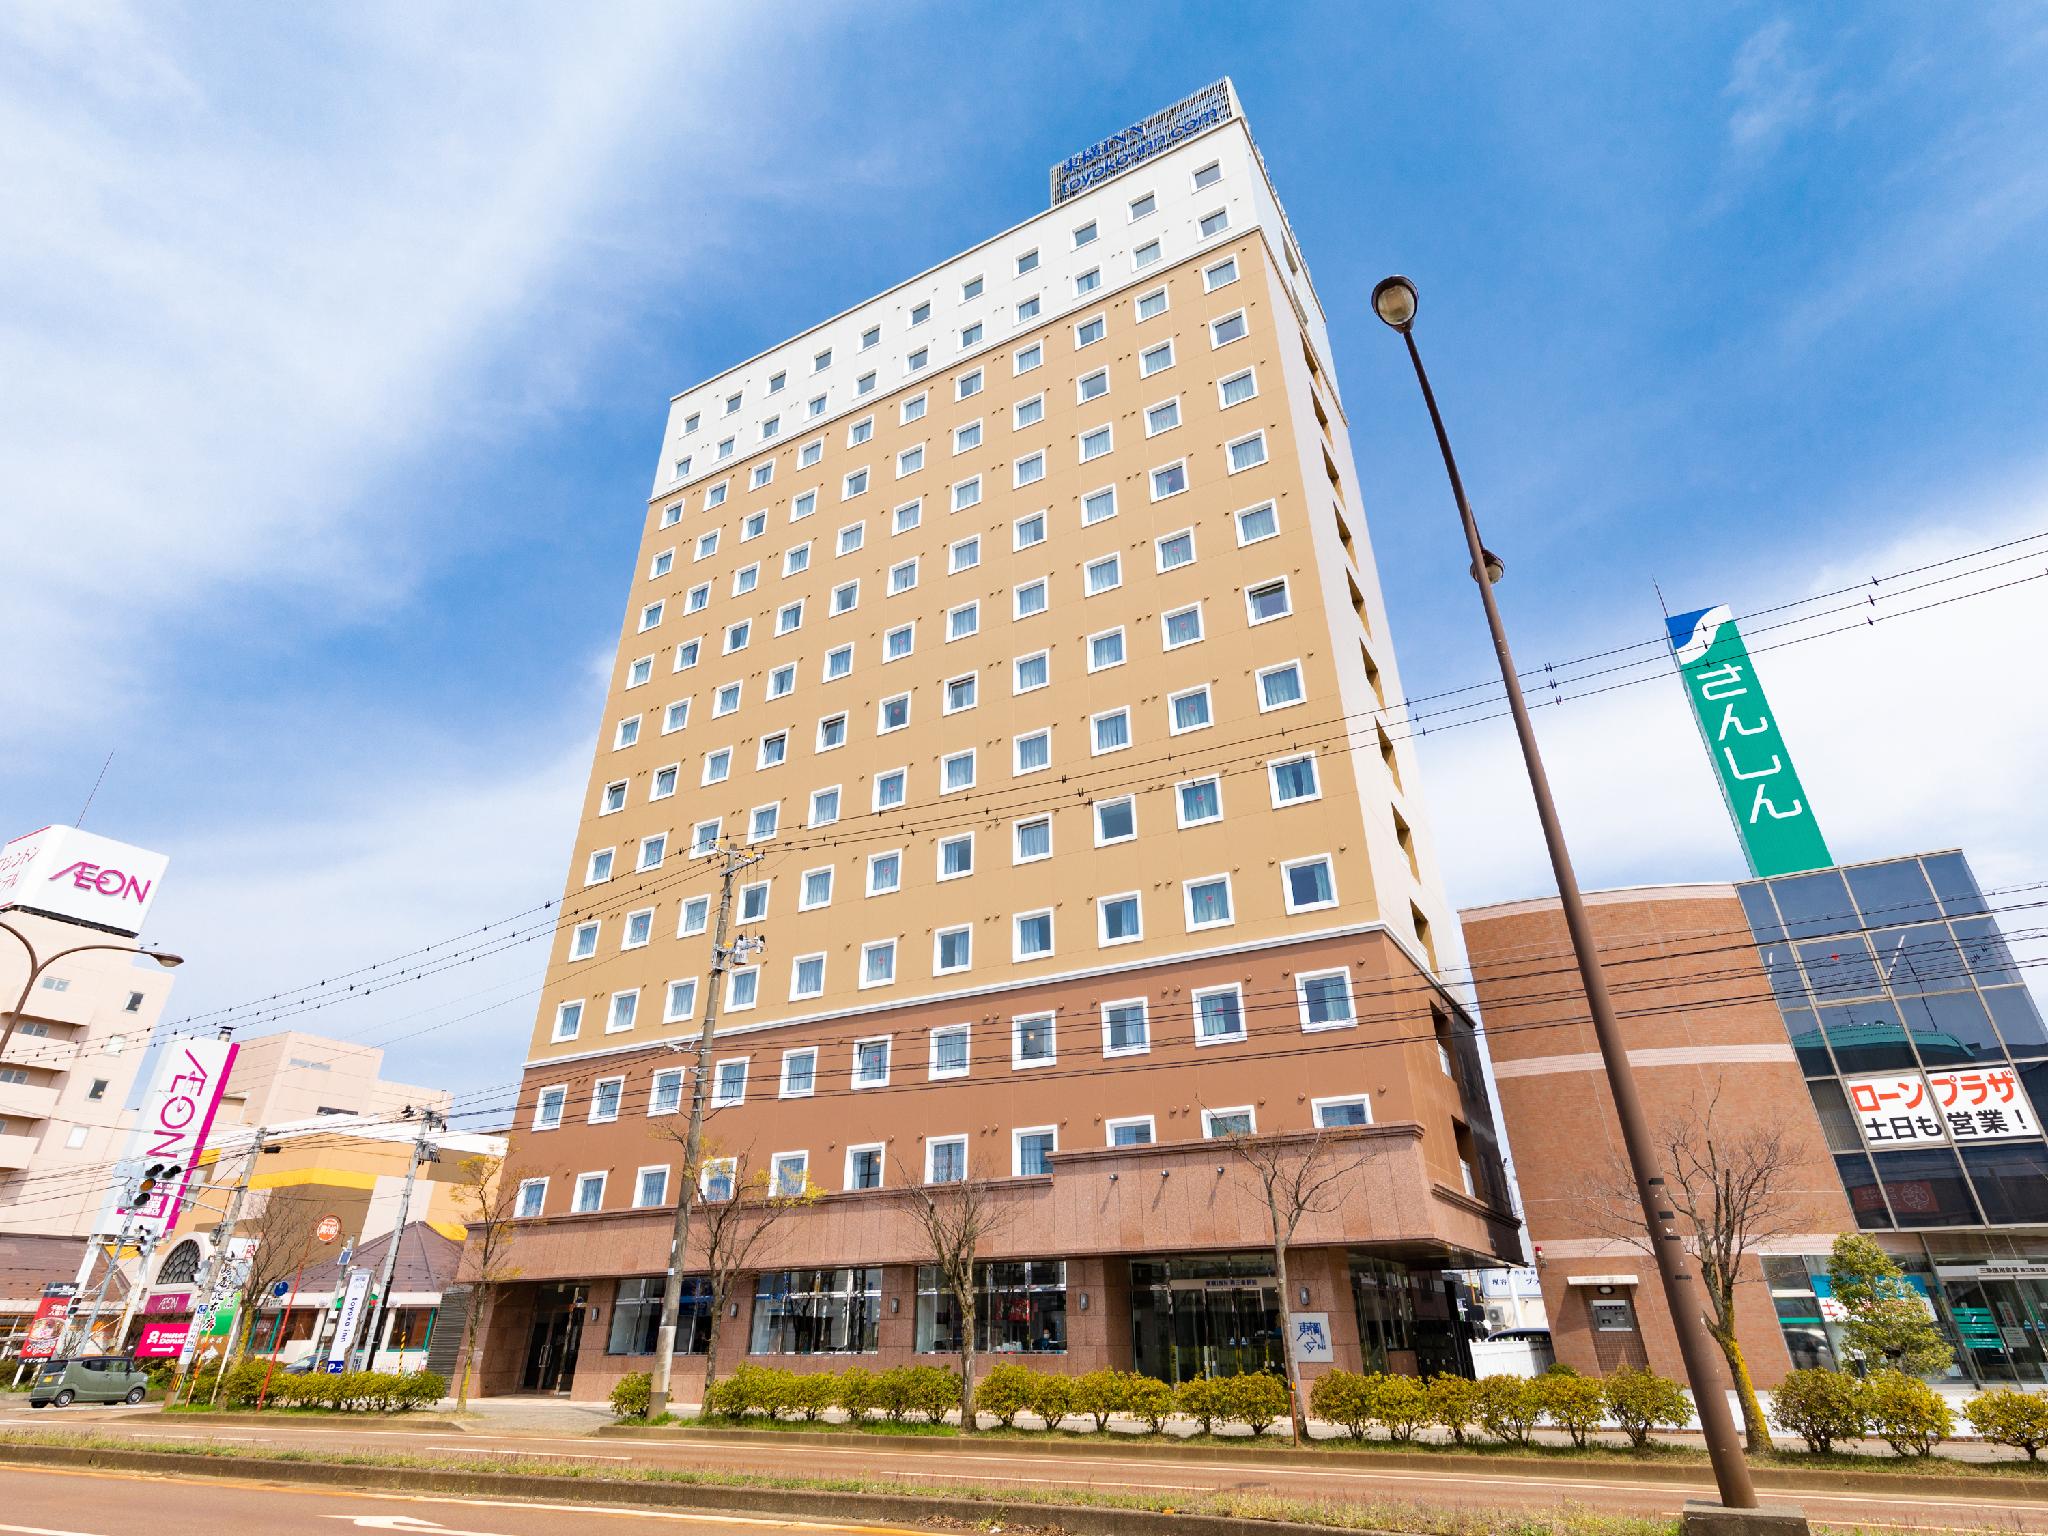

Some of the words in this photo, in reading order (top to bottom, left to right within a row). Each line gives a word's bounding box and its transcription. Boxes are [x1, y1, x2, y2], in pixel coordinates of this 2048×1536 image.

[1696, 663, 1803, 824] さんしん
[1850, 1069, 2016, 1112] ローンプラザ
